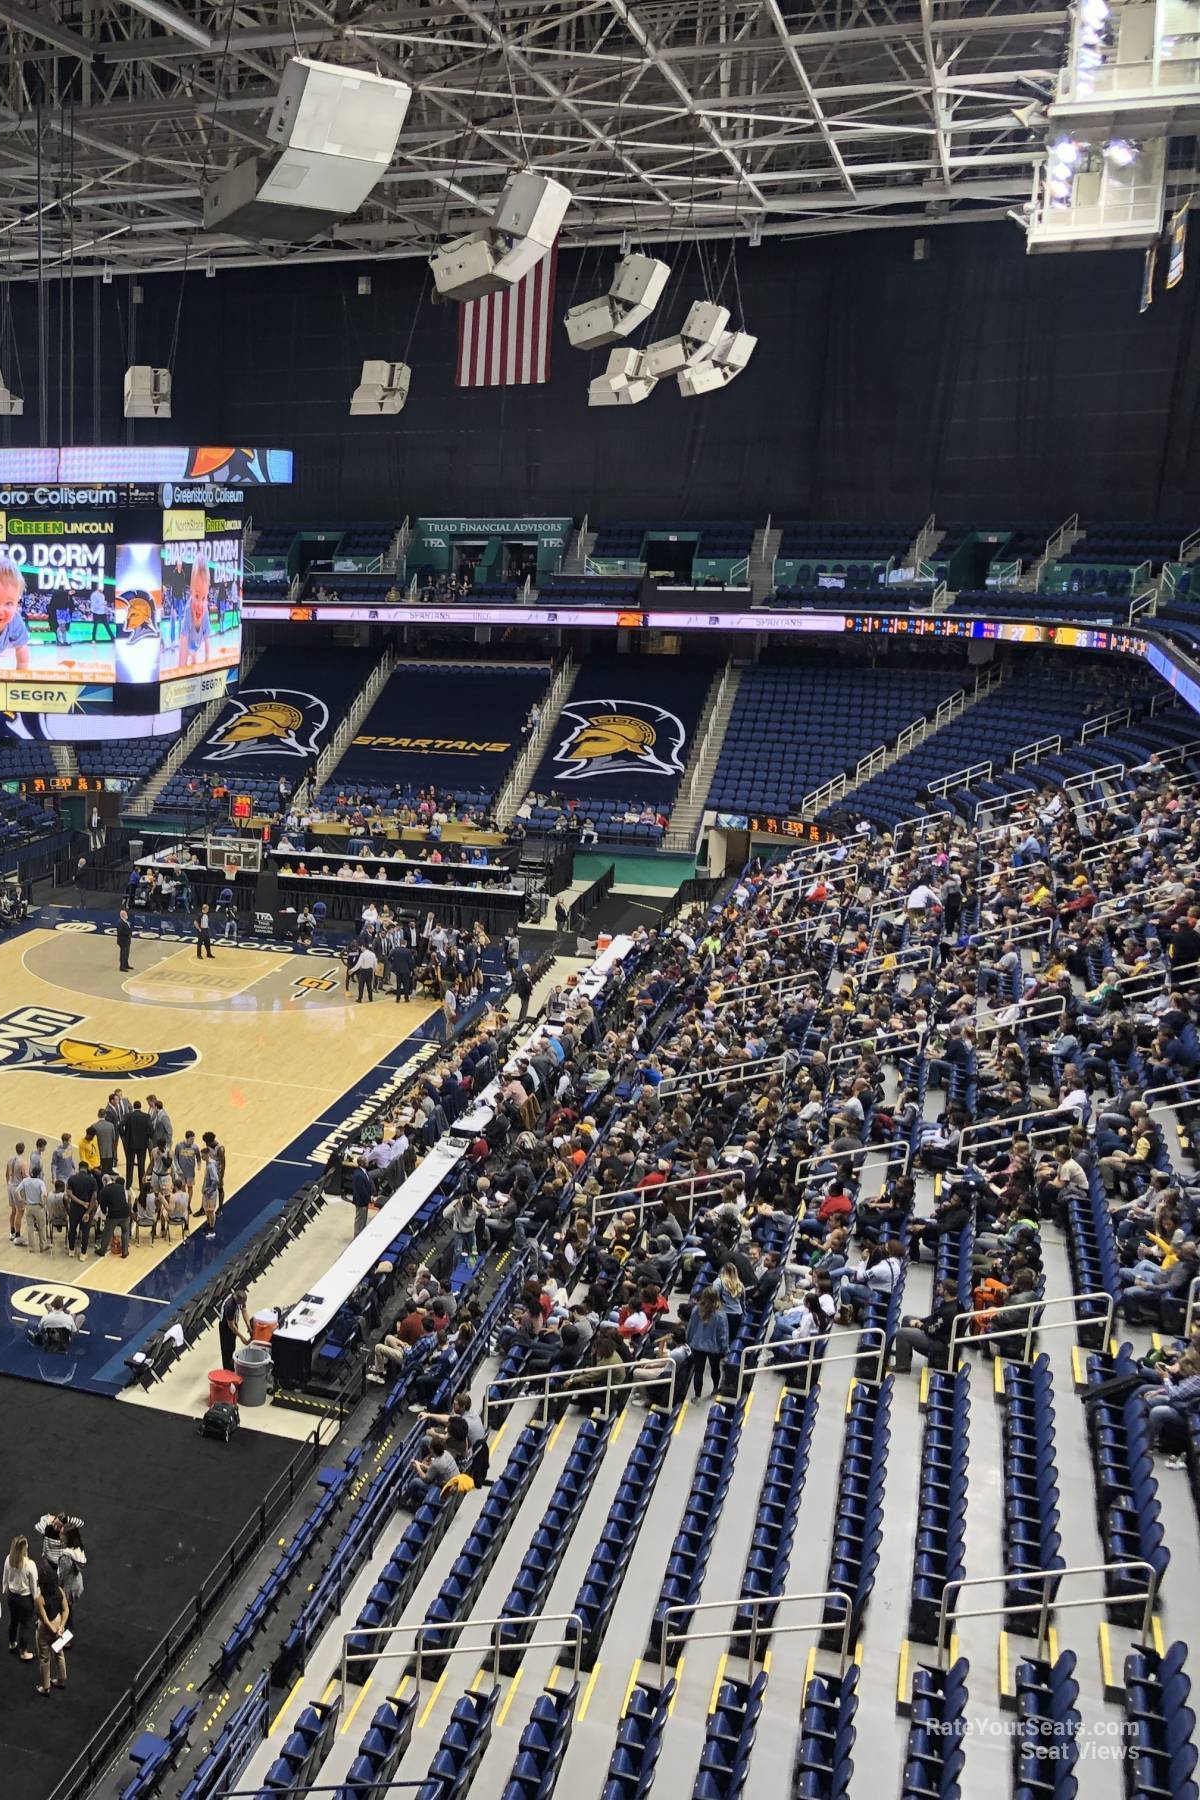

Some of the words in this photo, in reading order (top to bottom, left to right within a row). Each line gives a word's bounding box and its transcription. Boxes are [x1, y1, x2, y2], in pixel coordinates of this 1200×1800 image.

[33, 487, 118, 504] Coliseum
[174, 486, 214, 503] Greensboro
[215, 486, 244, 503] Coliseum
[7, 519, 64, 535] GREEN
[64, 522, 114, 534] LINCOLN
[427, 523, 457, 532] TRIAD
[459, 523, 511, 532] FINANCIAL
[513, 523, 562, 532] ADVISORS
[33, 543, 105, 567] DORM
[38, 567, 105, 591] DASH
[1011, 627, 1025, 641] 27
[1076, 632, 1088, 647] 26
[9, 690, 67, 702] SEGRA
[352, 736, 511, 753] SPARTANS
[254, 911, 273, 921] TFA
[104, 927, 294, 953] Greenboro
